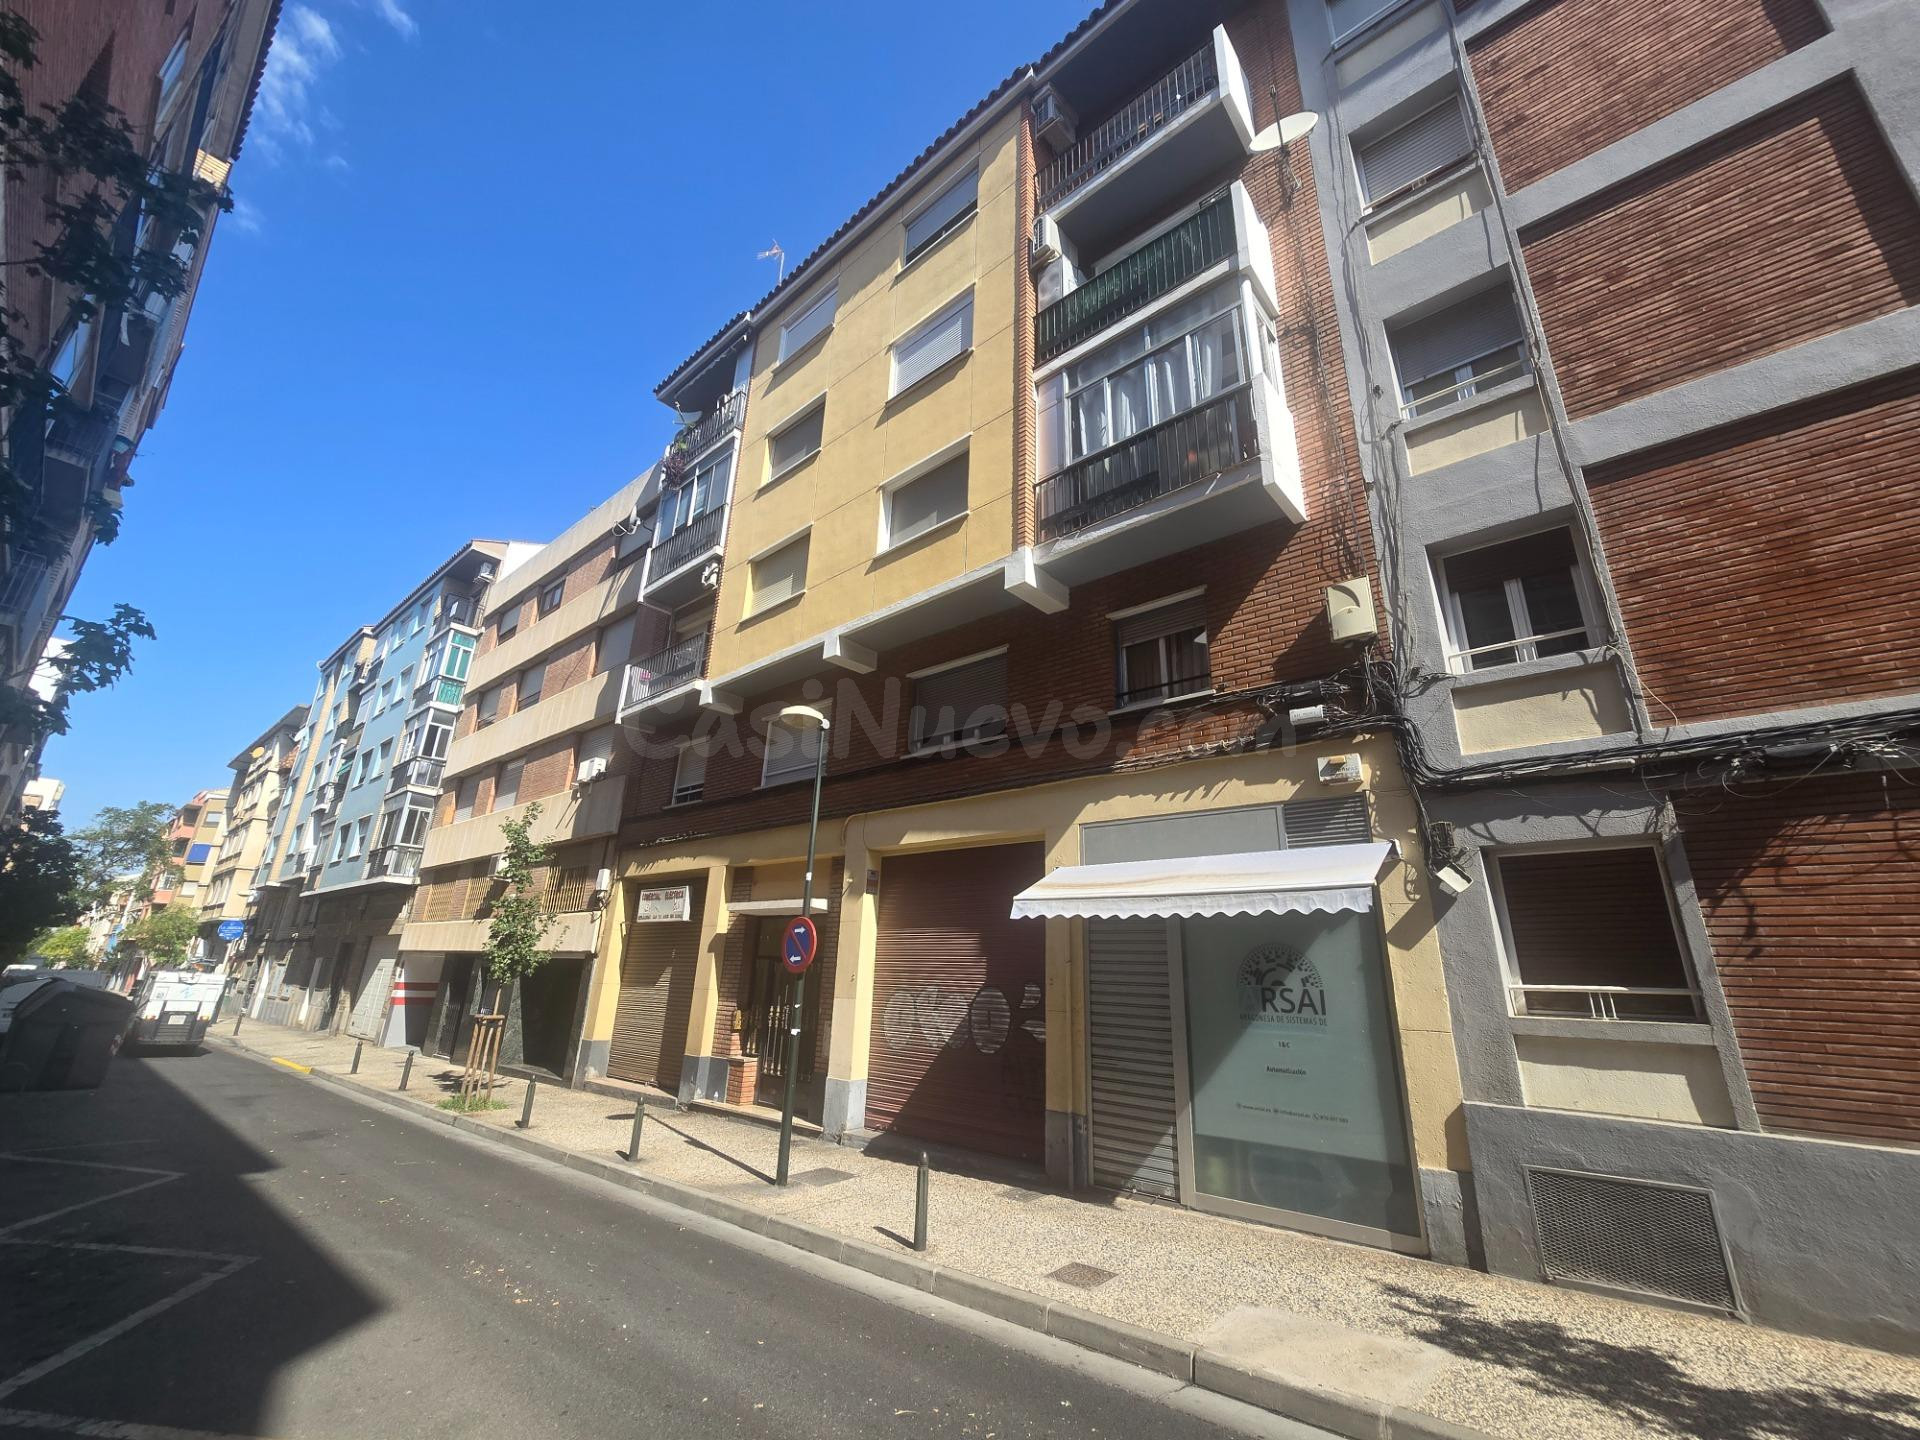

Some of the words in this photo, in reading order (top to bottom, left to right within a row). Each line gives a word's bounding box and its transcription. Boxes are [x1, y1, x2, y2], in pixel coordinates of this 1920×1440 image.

[1276, 1015, 1285, 1024] DE
[1286, 1015, 1318, 1026] SISTEMAS
[1319, 1017, 1328, 1027] DE
